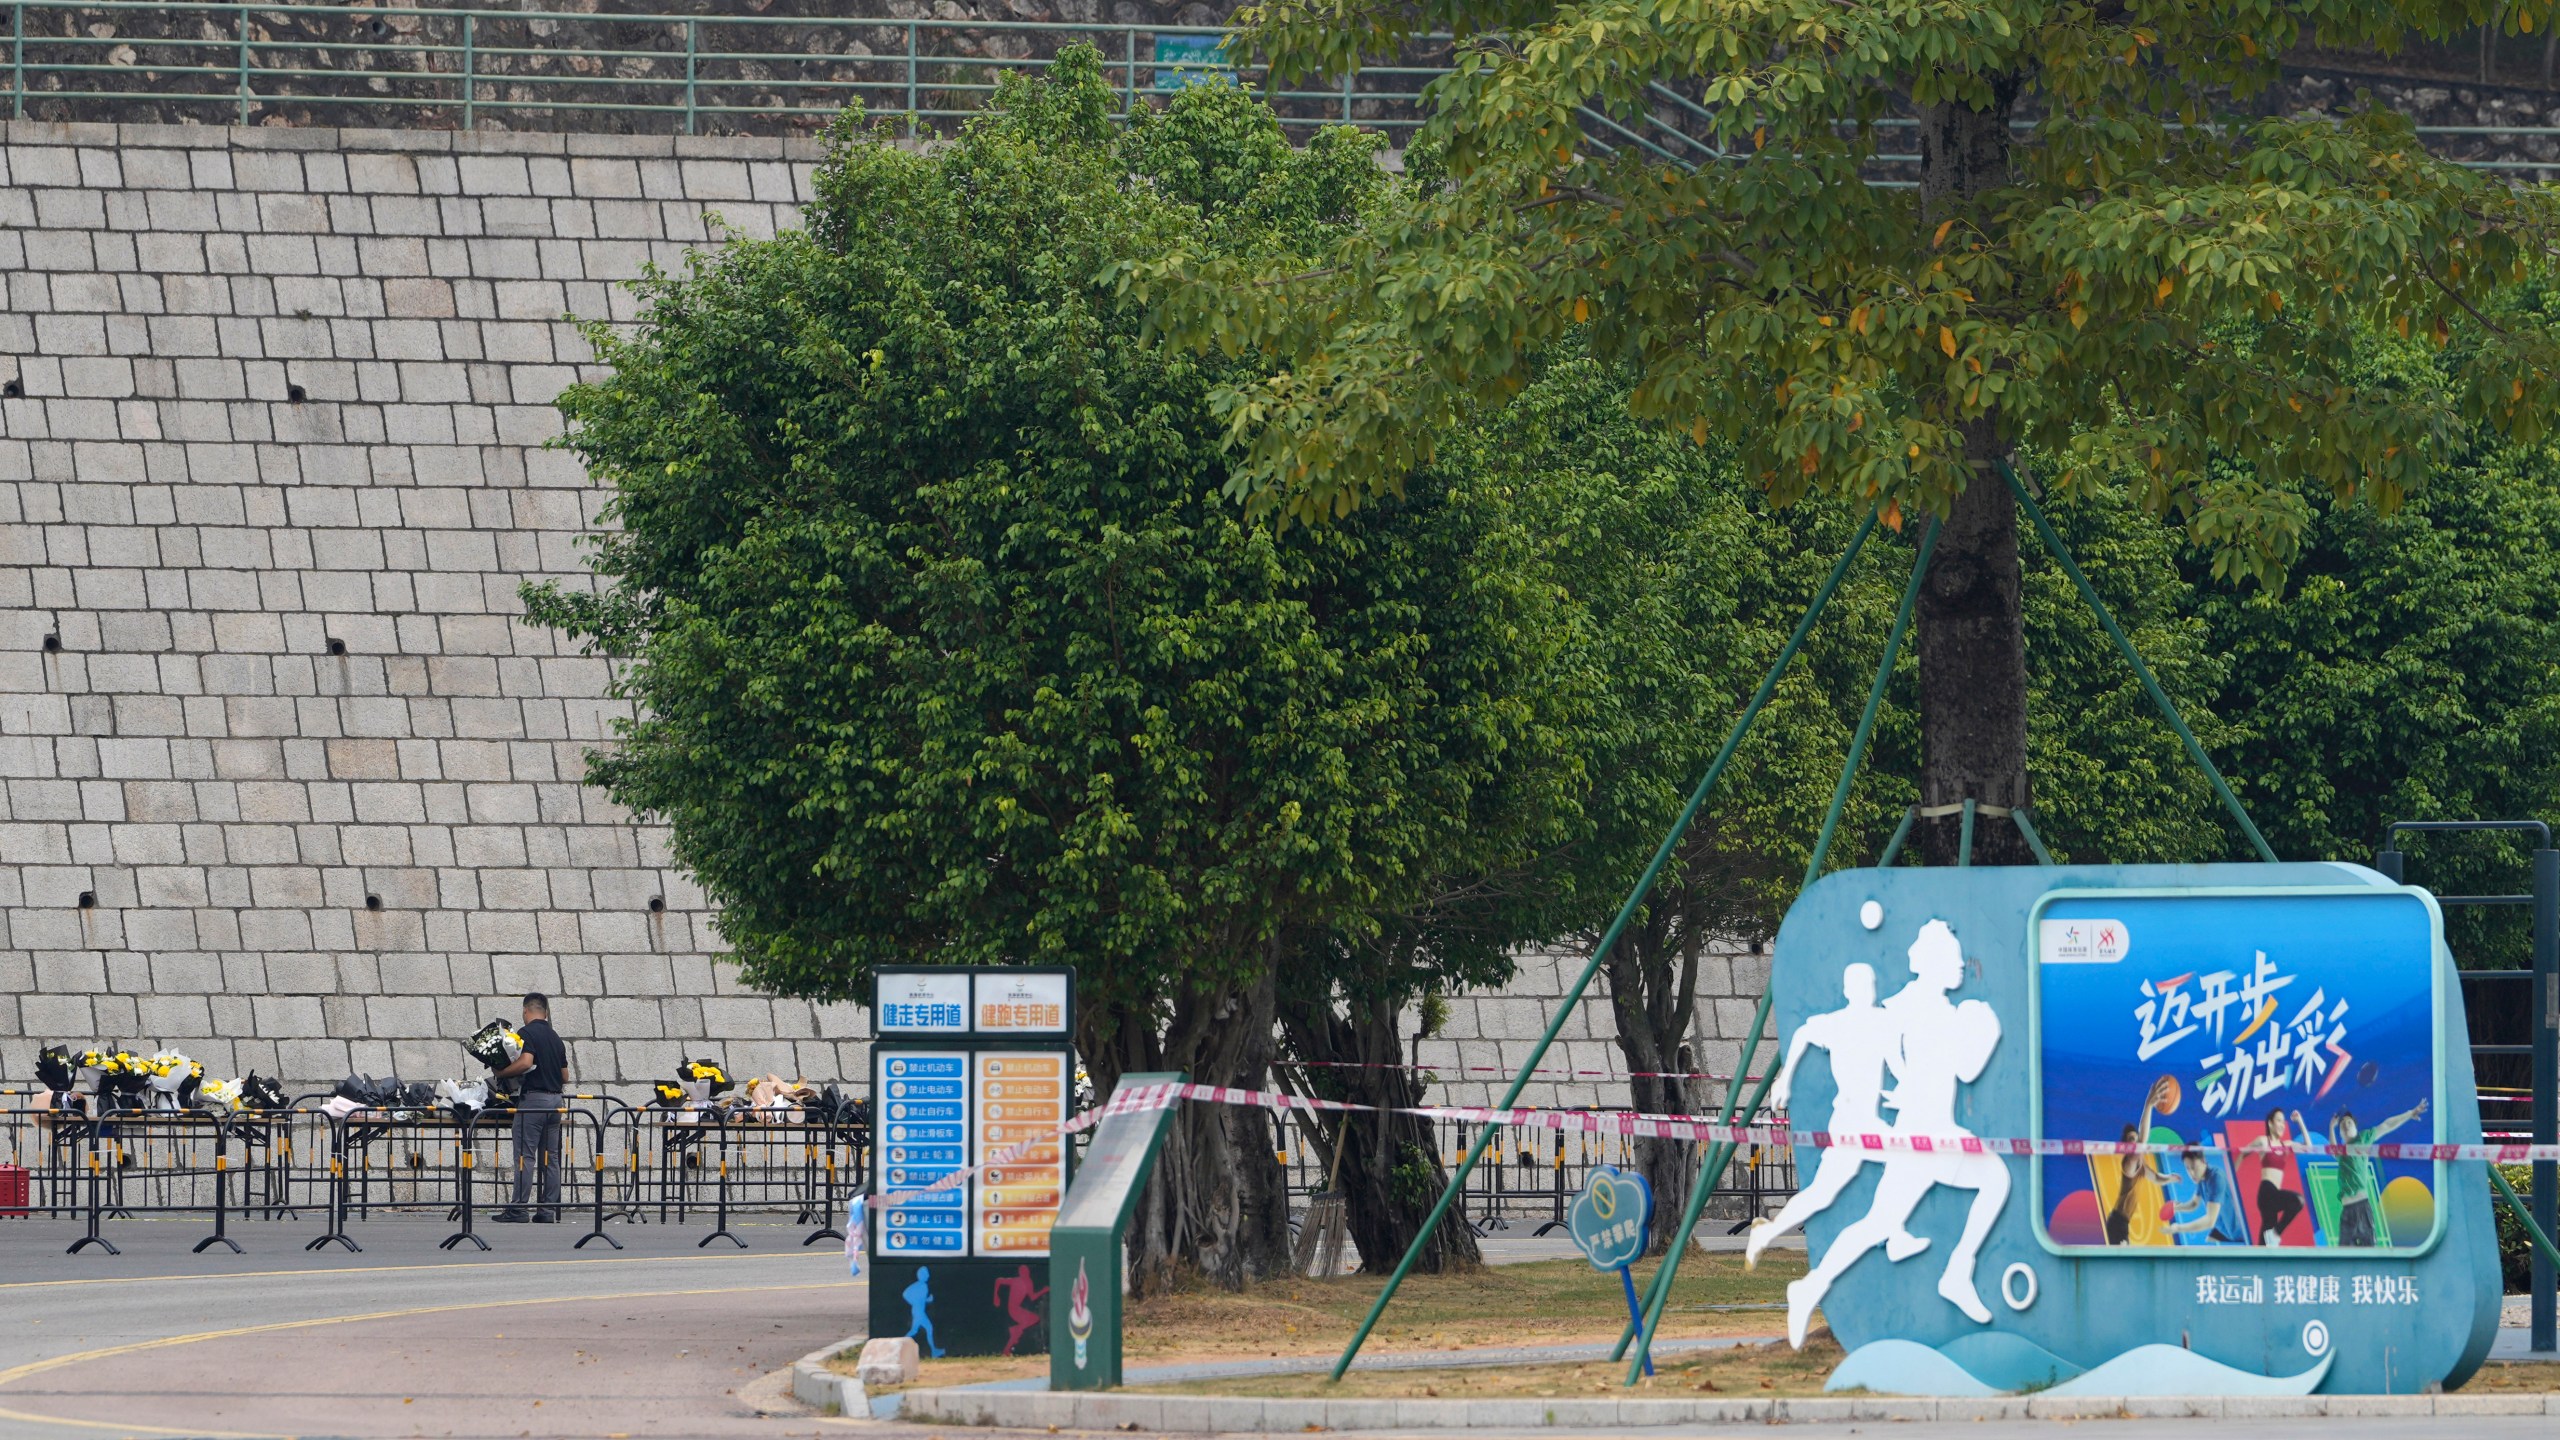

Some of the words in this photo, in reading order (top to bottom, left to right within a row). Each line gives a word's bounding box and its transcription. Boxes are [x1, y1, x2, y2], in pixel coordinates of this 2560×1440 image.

[2134, 949, 2299, 1062] 迈开步
[883, 1003, 961, 1027] 健走专用道
[982, 1003, 1060, 1027] 健跑专用道
[2195, 985, 2354, 1118] 动出彩
[909, 1063, 954, 1072] 禁止机动车
[909, 1085, 954, 1095] 禁止电动车
[909, 1107, 954, 1116] 禁止自行车
[909, 1129, 954, 1138] 禁止滑板车
[909, 1151, 954, 1160] 禁止轮滑
[909, 1172, 948, 1181] 禁止婴儿
[2196, 1275, 2264, 1305] 我运动
[2274, 1275, 2341, 1305] 我健康
[2351, 1275, 2419, 1305] 我快乐
